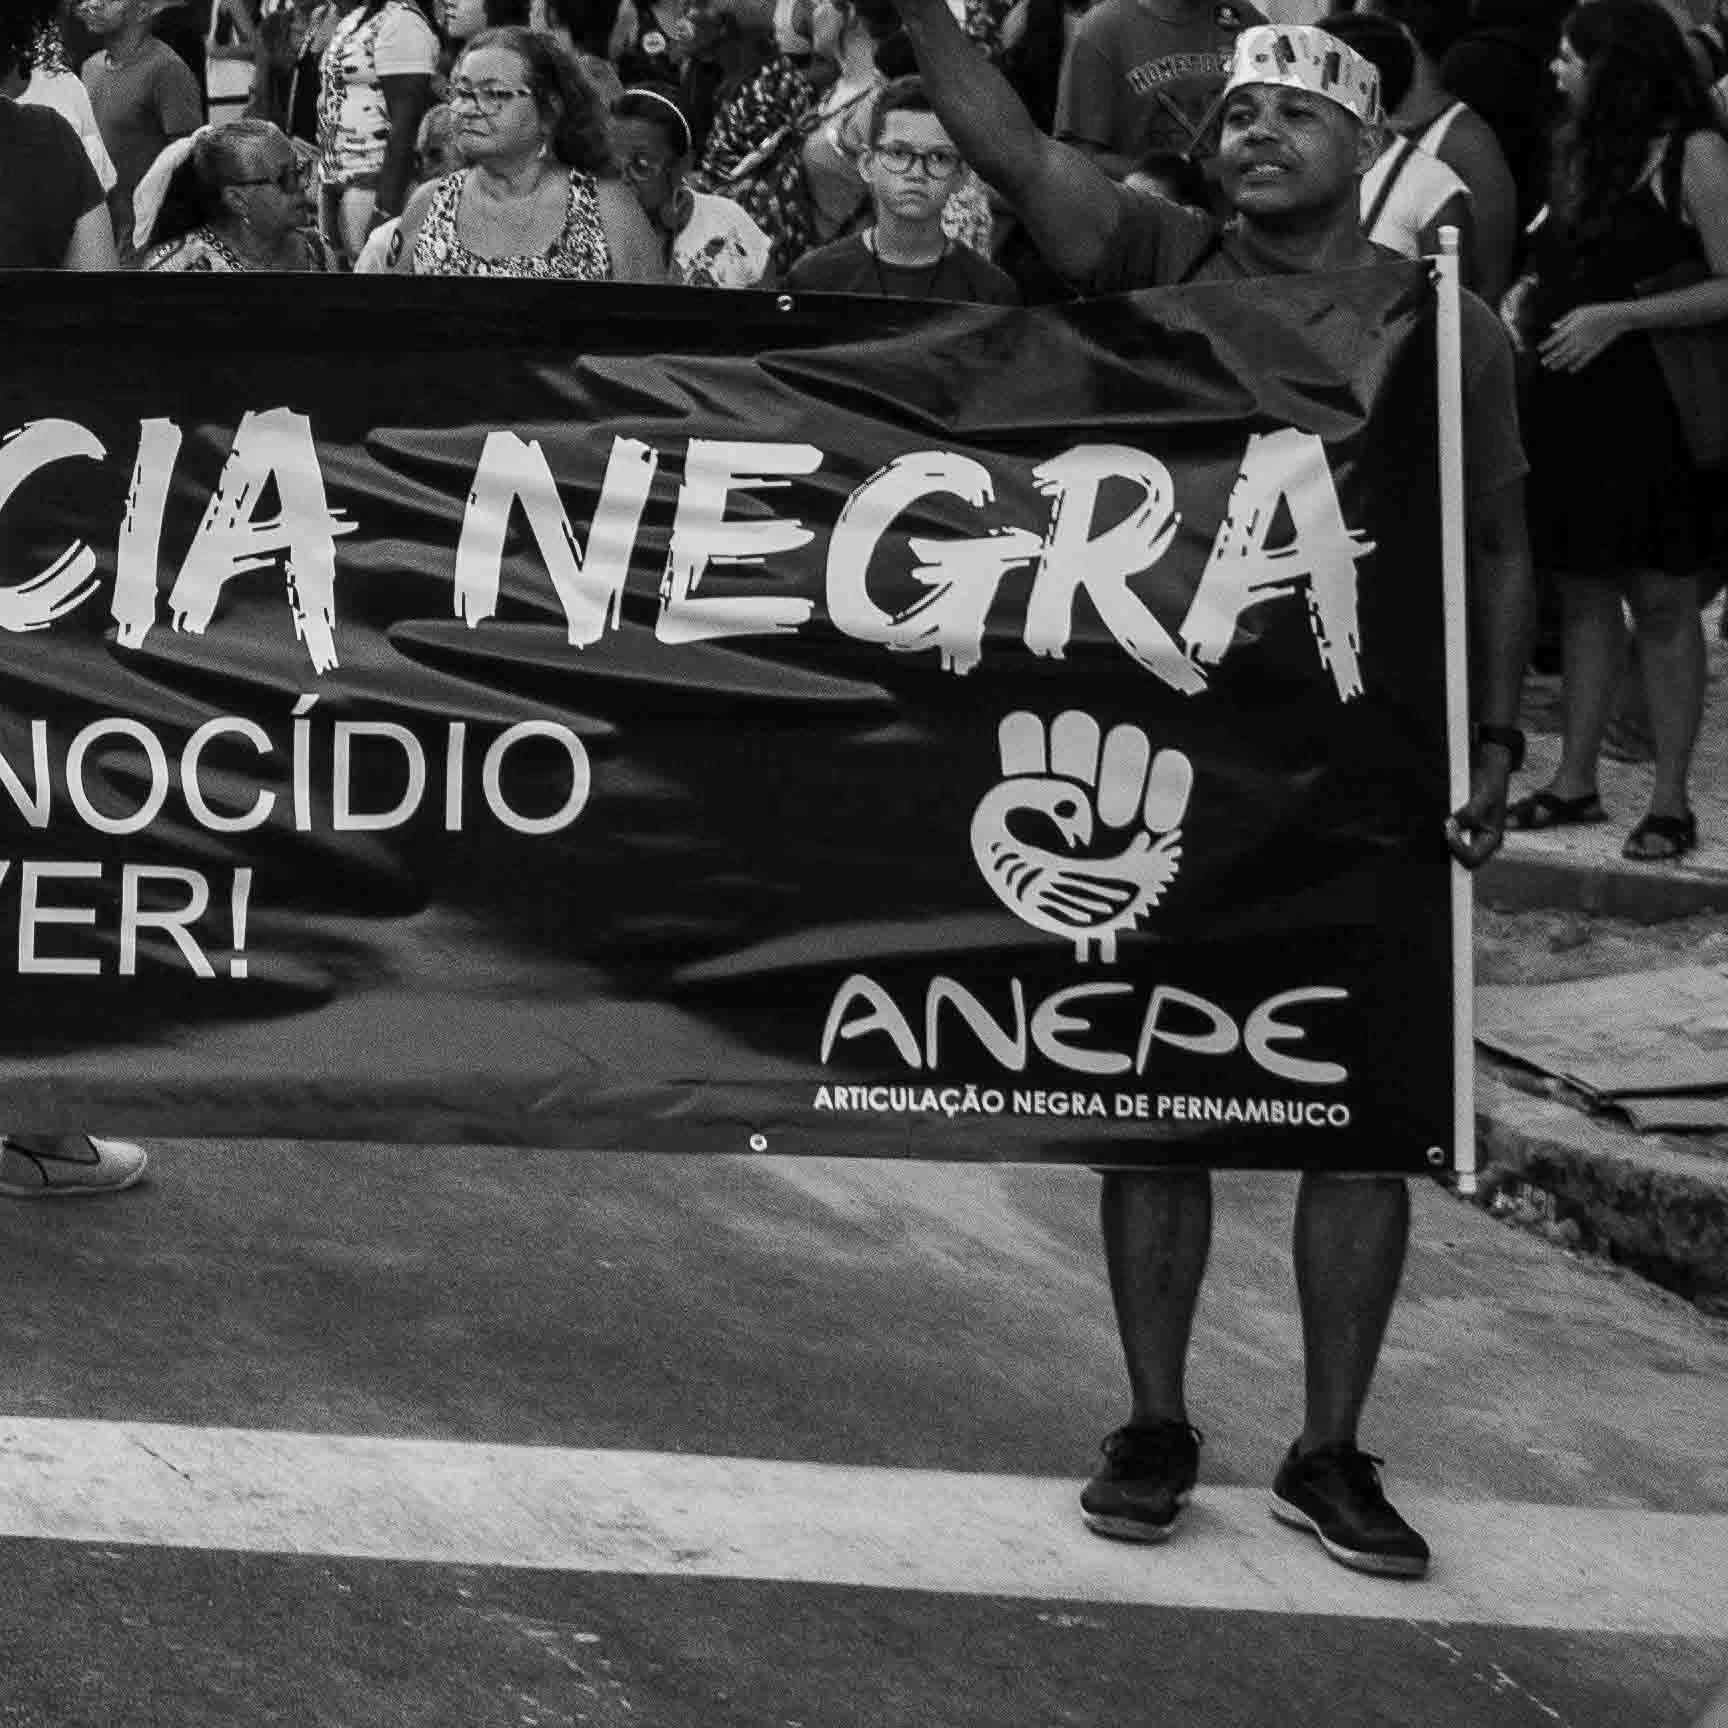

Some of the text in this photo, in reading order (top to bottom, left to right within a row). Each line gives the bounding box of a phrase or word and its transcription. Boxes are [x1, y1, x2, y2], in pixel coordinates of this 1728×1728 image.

[454, 428, 1375, 701] NEGRA
[821, 974, 1349, 1083] ANEPE
[814, 1084, 1350, 1127] ARTICULAÇÃO NEGRA DE PERNAMBUCO
